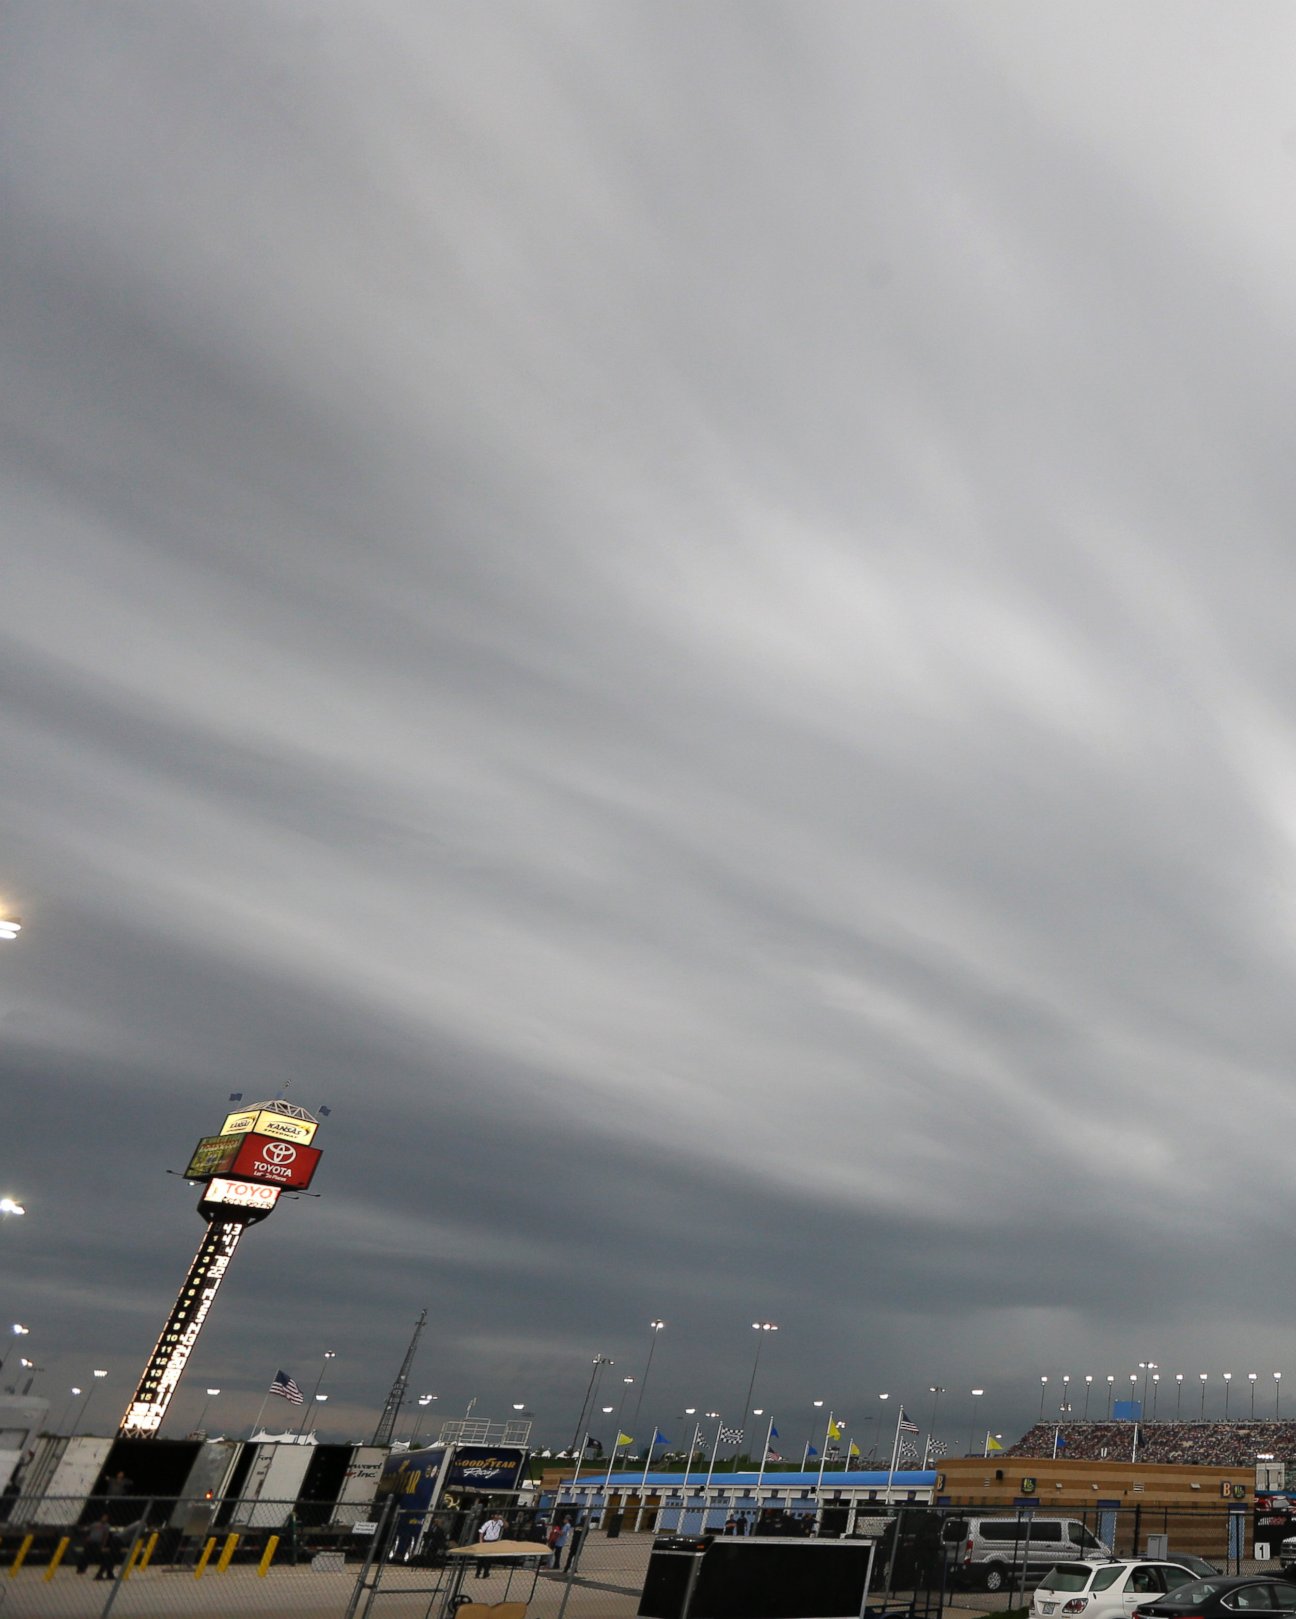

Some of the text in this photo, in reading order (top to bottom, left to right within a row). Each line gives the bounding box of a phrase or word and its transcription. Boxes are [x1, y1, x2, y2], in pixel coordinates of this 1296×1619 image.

[267, 1122, 301, 1136] KANSAS
[254, 1161, 292, 1177] TOYOTA
[223, 1223, 242, 1235] 43
[222, 1234, 239, 1246] 41
[225, 1246, 235, 1257] 4
[207, 1266, 225, 1278] 22
[454, 1457, 517, 1469] GOODYEAR
[1223, 1482, 1230, 1497] B
[1259, 1545, 1264, 1558] 1
